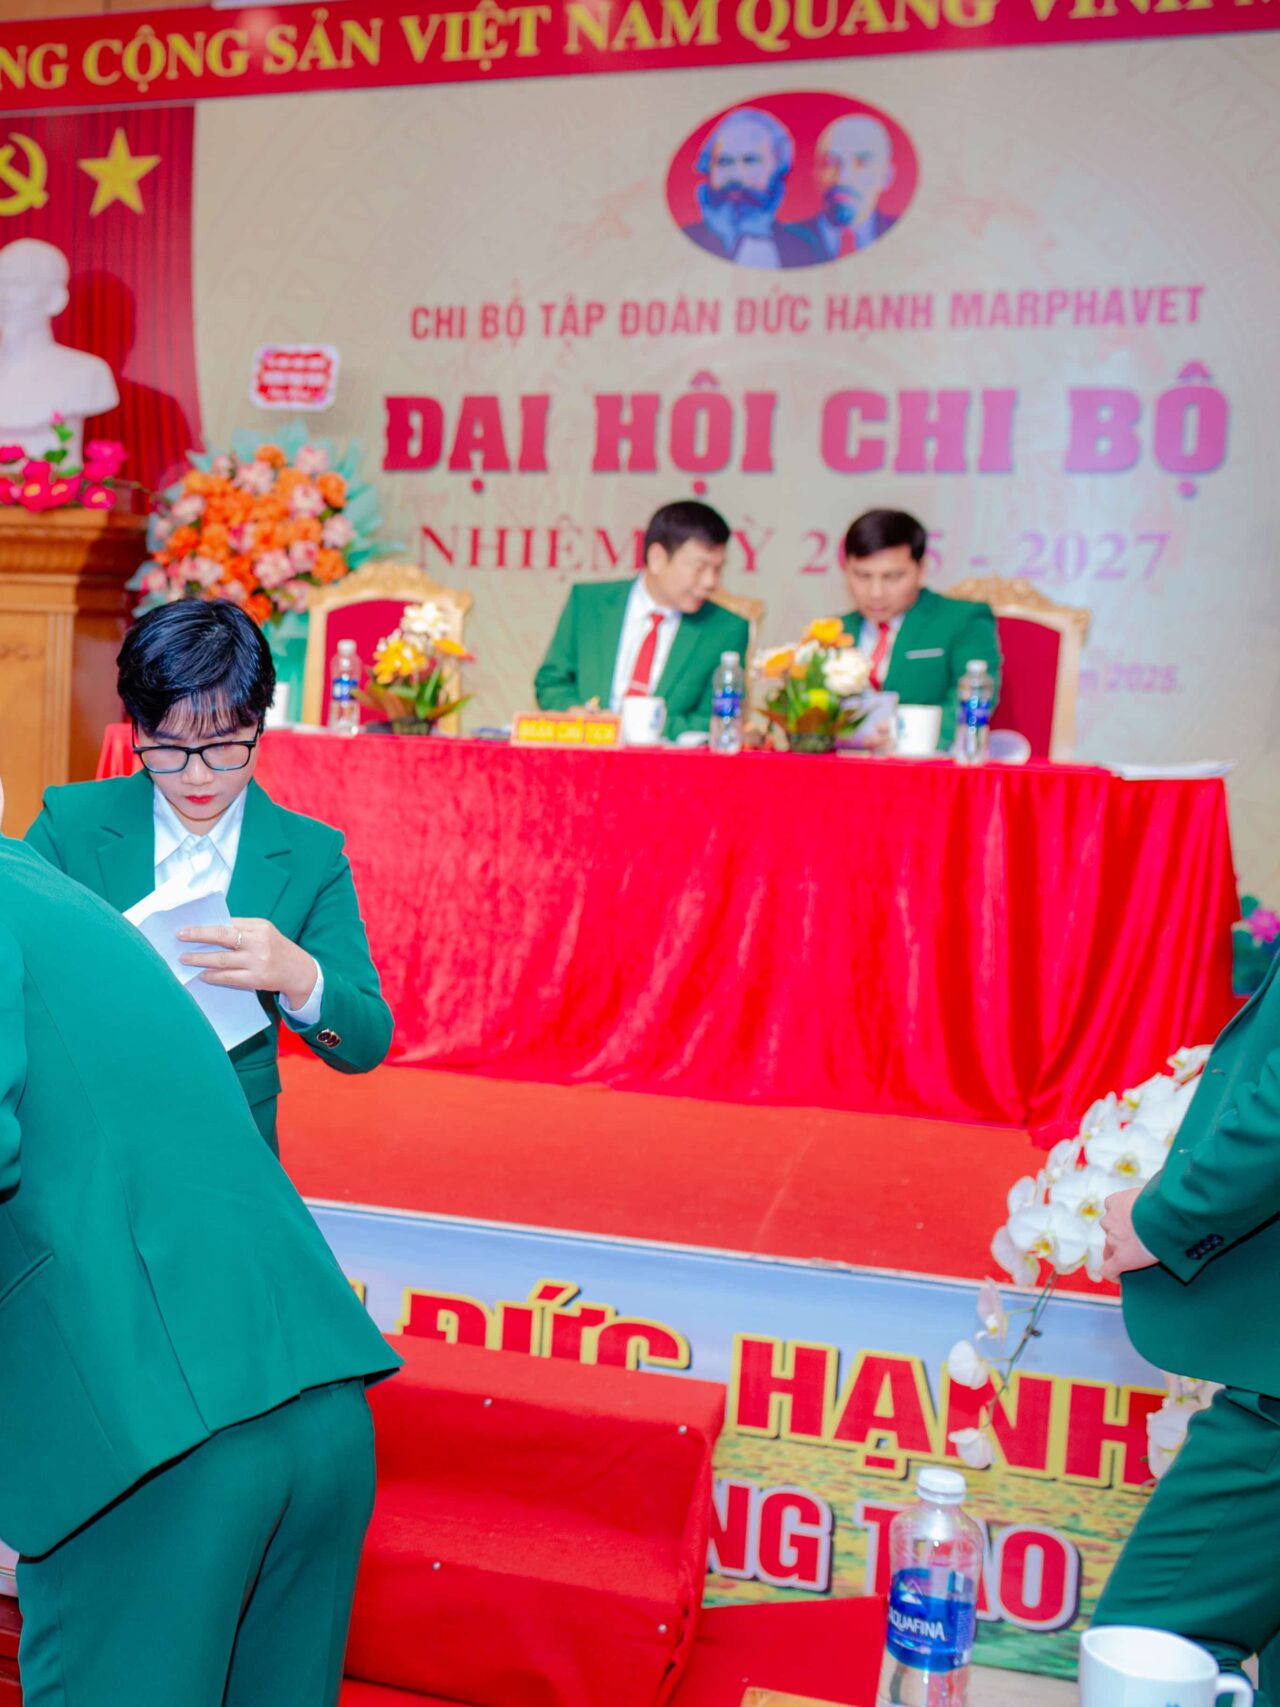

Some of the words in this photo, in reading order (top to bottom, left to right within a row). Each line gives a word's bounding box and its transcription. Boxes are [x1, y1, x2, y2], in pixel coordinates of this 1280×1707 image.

[82, 24, 249, 93] CỘNG
[262, 8, 384, 75] SẢN
[399, 0, 551, 71] VIỆT
[563, 0, 721, 54] NAM
[410, 302, 466, 341] CHI
[620, 288, 720, 336] ĐOÀN
[825, 292, 933, 341] HẠNH
[949, 285, 1204, 332] MARPHAVET
[382, 393, 551, 494] ĐẠI
[591, 369, 778, 496] HỘI
[819, 386, 1019, 475] CHI
[1063, 360, 1231, 499] BỘ
[412, 514, 646, 584] NHIỆM
[728, 513, 773, 573] Ỳ
[799, 529, 944, 576] 25
[1015, 531, 1172, 582] 2027
[730, 1333, 1172, 1495] HẠNH
[859, 1500, 1072, 1627] TO
